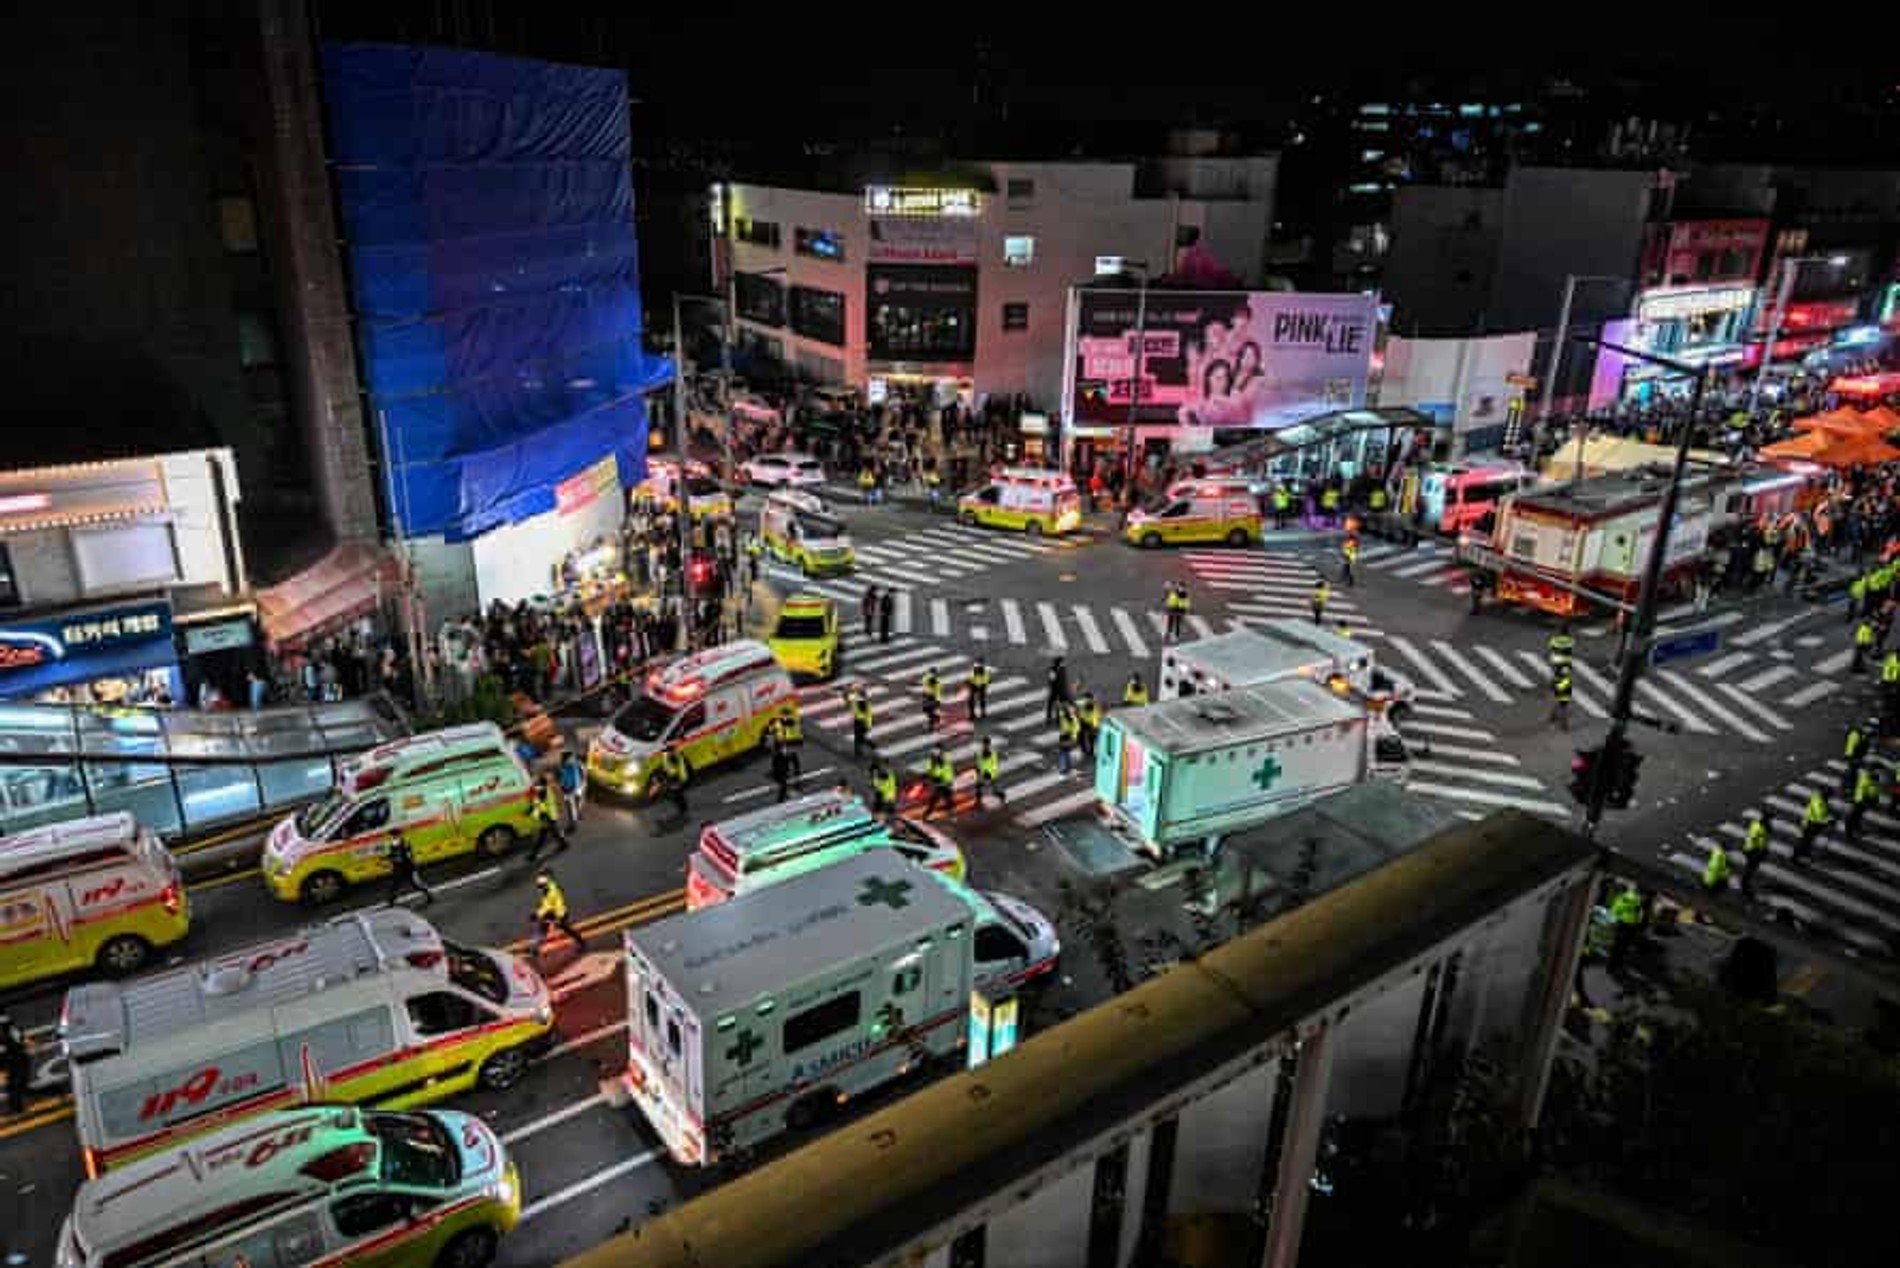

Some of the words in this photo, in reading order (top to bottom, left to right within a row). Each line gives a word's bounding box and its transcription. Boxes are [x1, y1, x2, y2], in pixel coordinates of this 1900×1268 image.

[1274, 312, 1328, 343] PINK
[1326, 324, 1366, 354] LIE
[138, 1065, 221, 1123] 119
